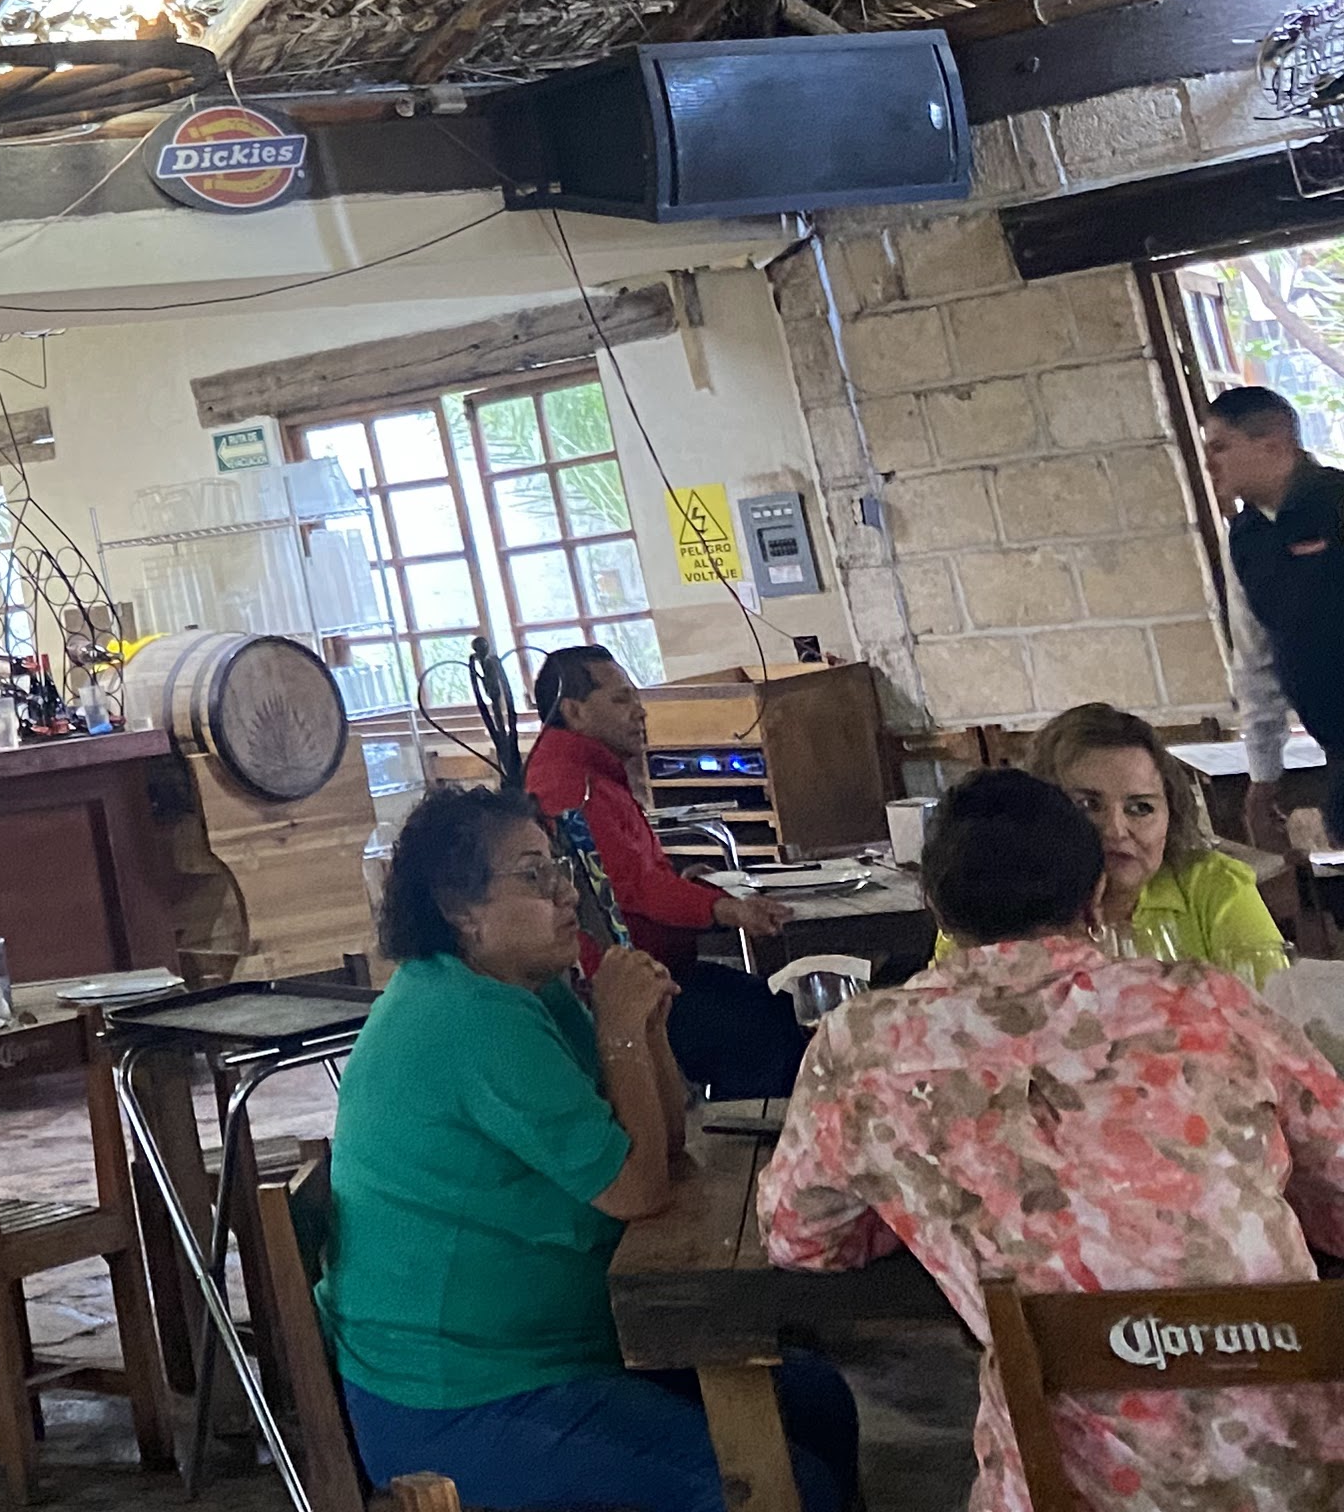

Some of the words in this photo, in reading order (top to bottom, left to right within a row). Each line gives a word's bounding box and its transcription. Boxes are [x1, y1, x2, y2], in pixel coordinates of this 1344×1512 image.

[172, 143, 294, 171] Dickies
[694, 557, 724, 569] ALO
[1109, 1314, 1302, 1370] Corona
